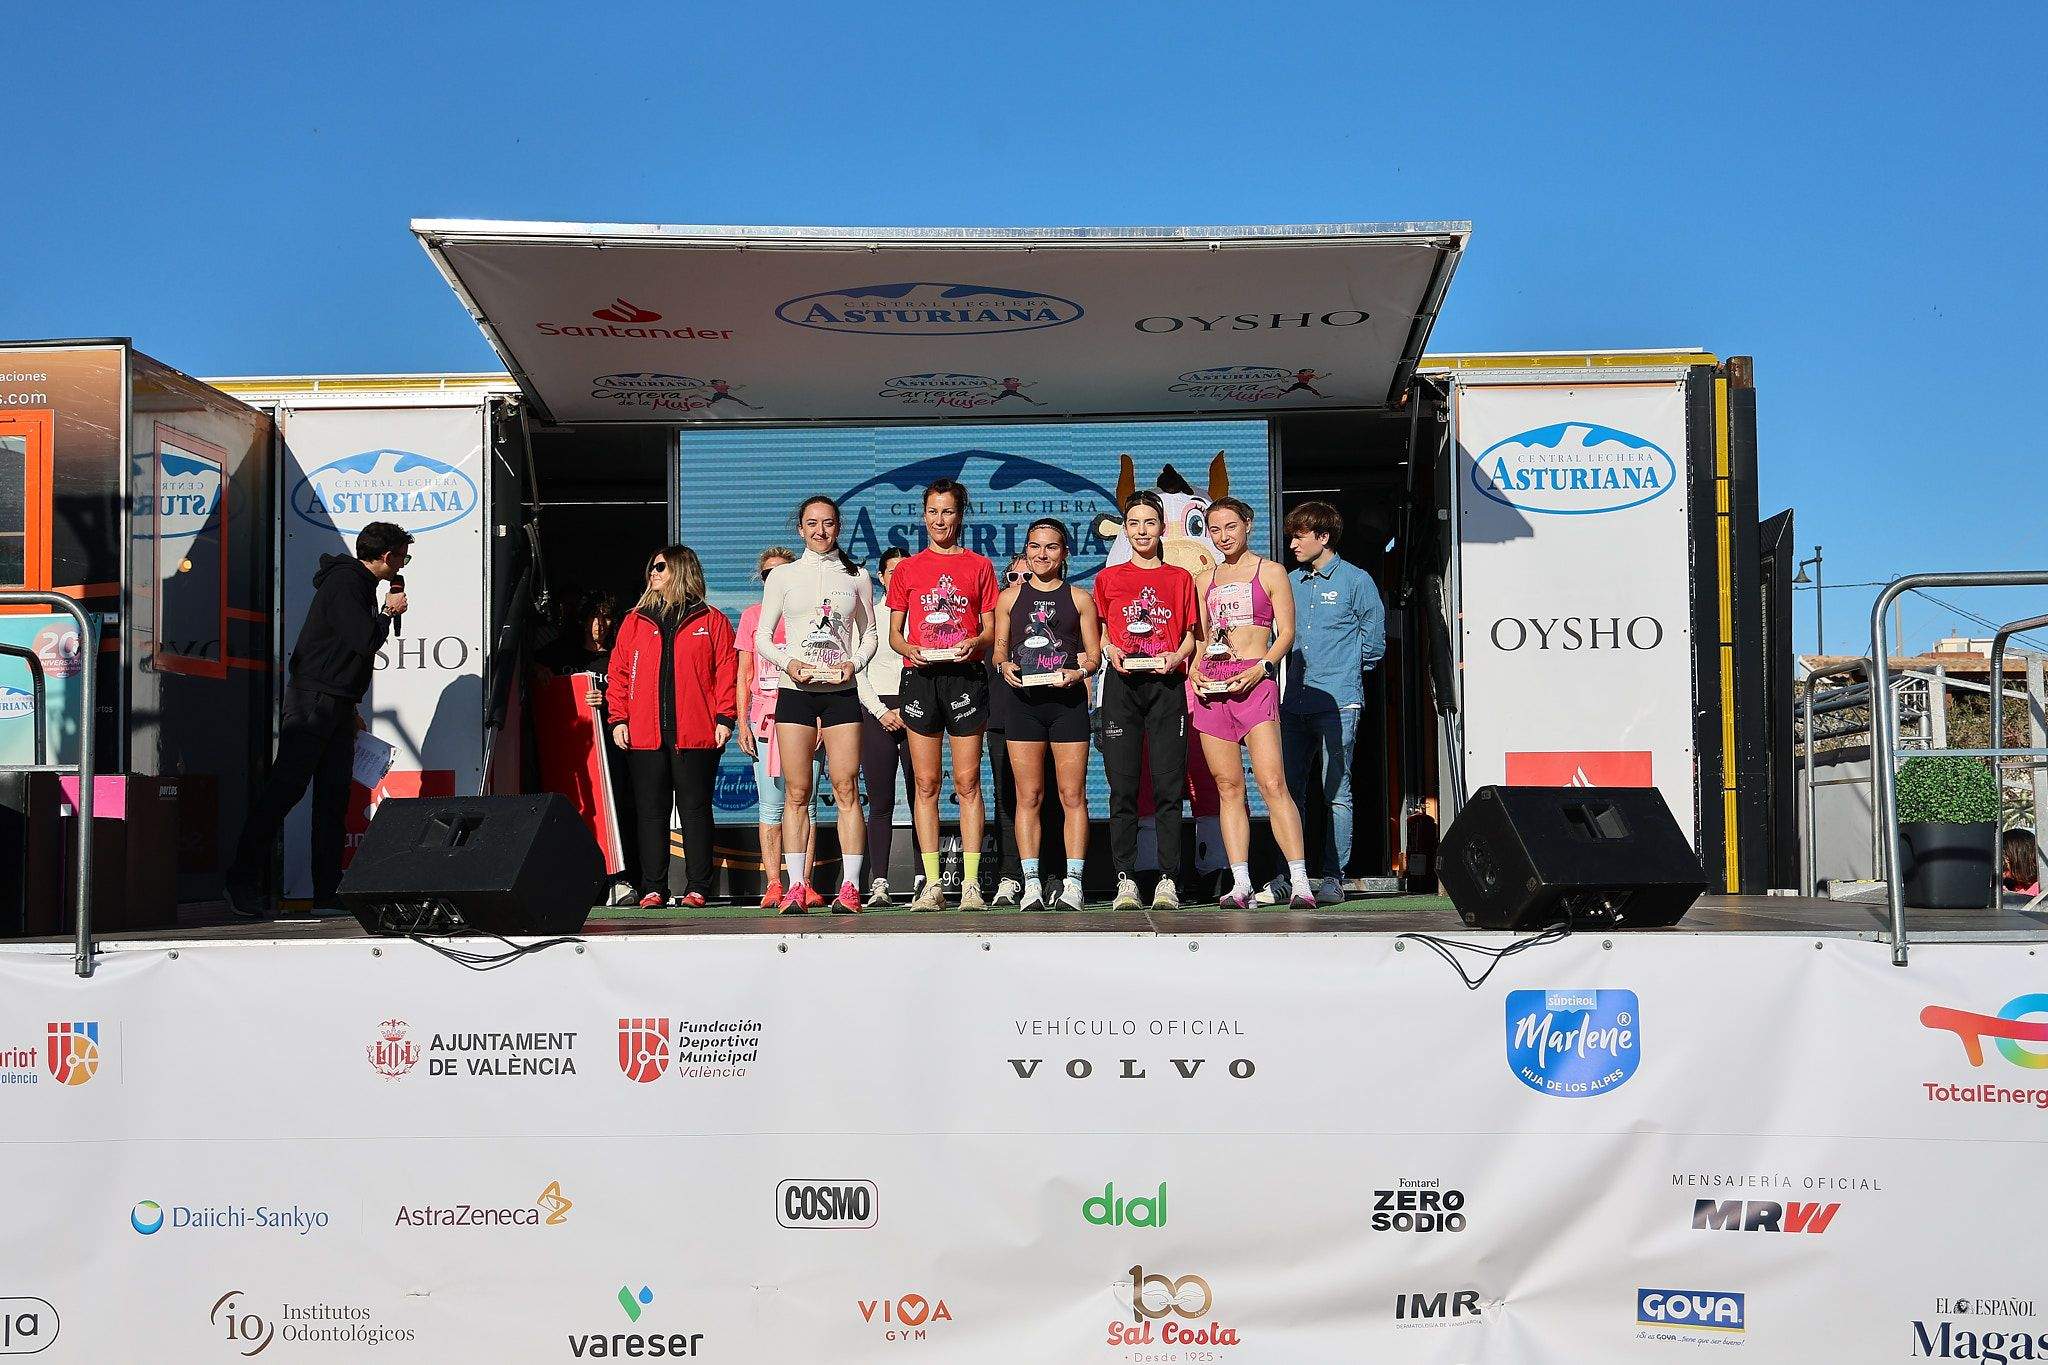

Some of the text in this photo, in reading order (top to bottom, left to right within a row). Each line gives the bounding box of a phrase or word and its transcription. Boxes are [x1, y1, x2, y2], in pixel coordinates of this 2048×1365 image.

[802, 303, 1062, 323] ASTURIANA
[1134, 310, 1370, 333] OYSHO
[536, 322, 733, 340] Santander
[0, 371, 47, 381] aciones
[604, 379, 697, 387] ASTURIANA
[591, 389, 681, 398] Carrera
[879, 389, 969, 398] Carrera
[1168, 384, 1260, 392] Carrera
[1220, 389, 1284, 402] Mujer
[650, 398, 712, 412] Mujer
[935, 396, 998, 409] Mujer
[1518, 453, 1654, 463] CENTRAL LECHERA
[335, 478, 458, 488] CENTRAL LECHERA
[1487, 456, 1661, 491] ASTURIANA
[306, 482, 464, 514] ASTURIANA
[891, 499, 1098, 515] CEAL LECHERA
[1490, 616, 1663, 651] OYSHO
[373, 636, 469, 671] SHO
[1037, 653, 1065, 671] Mujer
[0, 702, 33, 711] RIANA
[679, 1020, 761, 1032] Fundación
[1015, 1017, 1244, 1035] VEHÍCULO OFICIAL
[430, 1032, 577, 1052] AJUNTAMENT
[679, 1035, 758, 1050] Deportiva
[1514, 1012, 1632, 1069] Marlene
[429, 1054, 576, 1076] DE VALÈNCIA
[679, 1050, 757, 1065] Municipal
[679, 1066, 746, 1077] València
[1007, 1058, 1256, 1078] VOLVO
[1521, 1066, 1624, 1092] HIJA DE LOS ALPES
[1399, 1178, 1439, 1188] Fontarel
[1672, 1174, 1881, 1191] MENSAJERÍA OFICIAL
[785, 1186, 870, 1221] COSMO
[1082, 1181, 1167, 1228] dial
[172, 1205, 329, 1235] Daiichi-Sankyo
[394, 1205, 539, 1226] AstraZeneca
[1371, 1212, 1467, 1233] SODIO
[1691, 1199, 1841, 1233] MRW
[282, 1303, 371, 1320] Institutos
[857, 1293, 952, 1326] VIVA
[1396, 1290, 1482, 1319] IMR
[1642, 1294, 1742, 1323] GOYA
[1936, 1297, 2036, 1317] EL ESPAÑOL
[226, 1302, 264, 1341] io
[282, 1324, 415, 1345] Odontológicos
[885, 1329, 926, 1341] GYM
[1107, 1320, 1241, 1346] Sal Costa
[568, 1333, 704, 1358] vareser
[1134, 1352, 1214, 1362] Desde 1925
